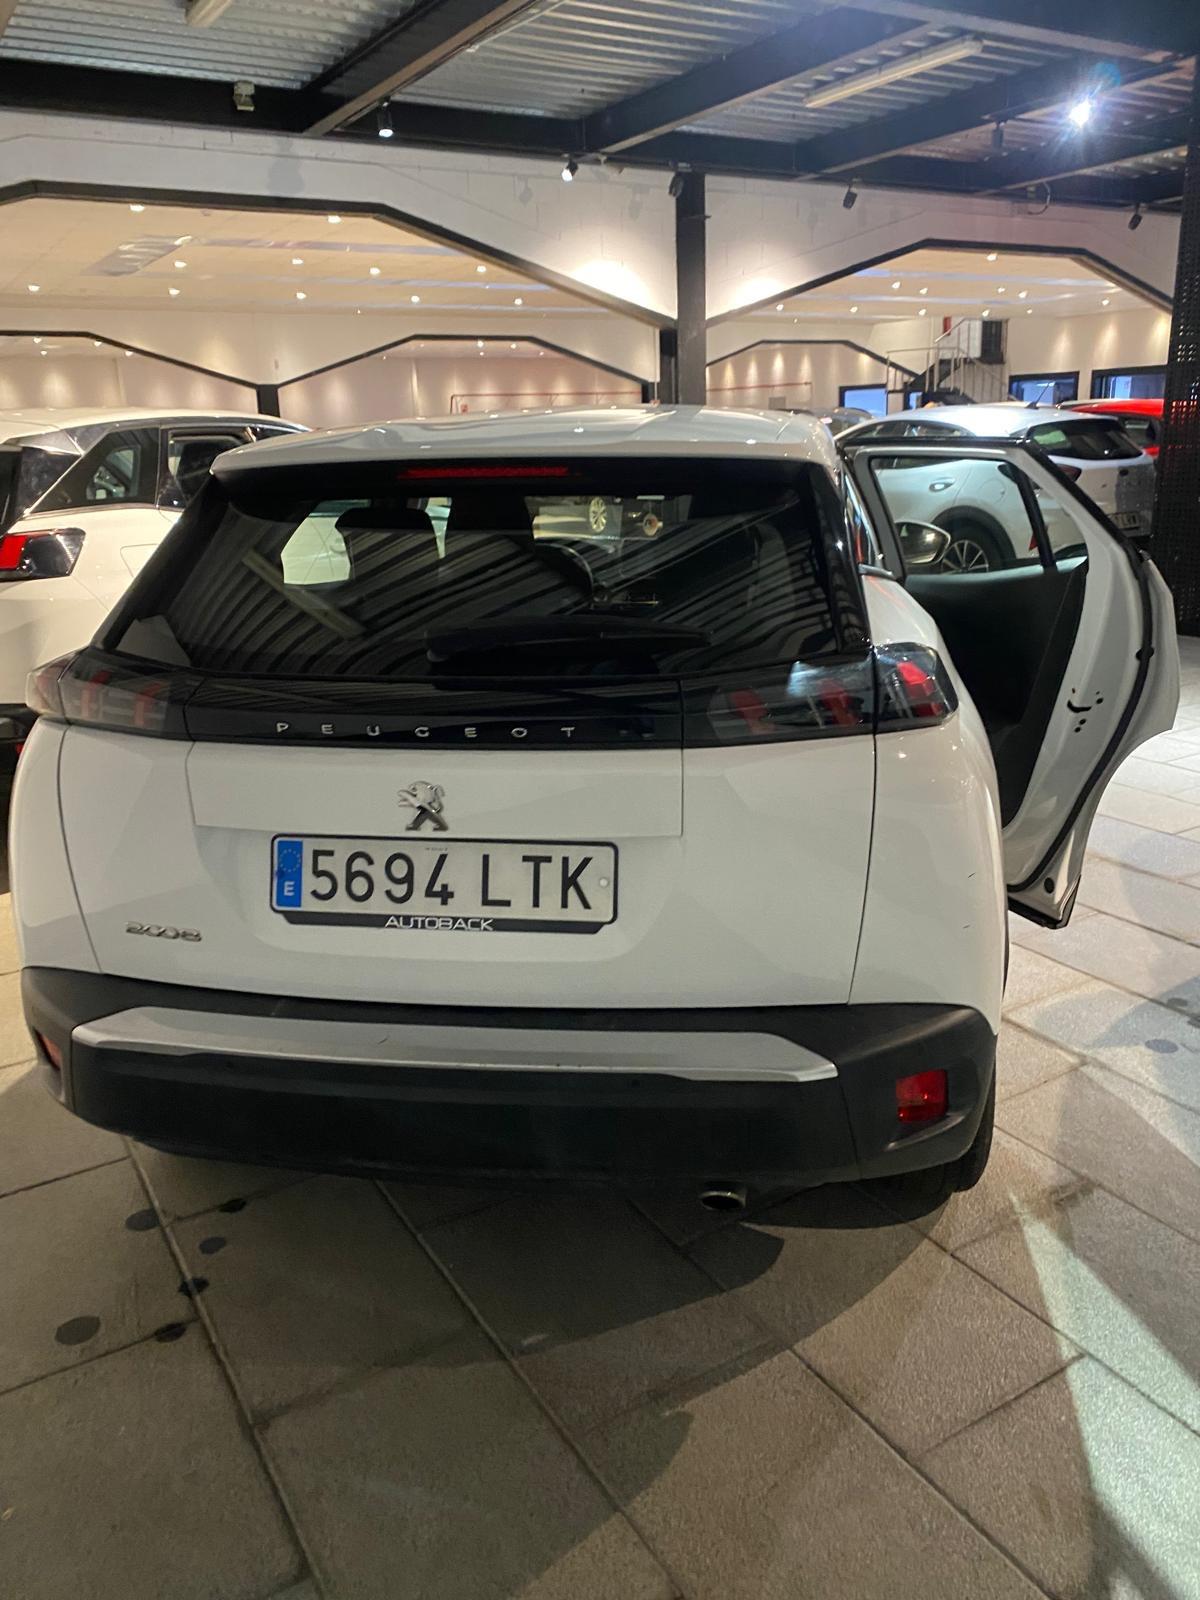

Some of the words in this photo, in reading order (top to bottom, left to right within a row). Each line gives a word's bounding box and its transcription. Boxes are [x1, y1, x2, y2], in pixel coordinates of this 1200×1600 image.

[276, 722, 577, 739] PEUGEOT
[282, 881, 295, 897] E
[310, 849, 454, 906] 5694
[481, 854, 594, 910] LTK
[124, 920, 202, 942] 2008
[384, 915, 494, 932] AUTOBACK
